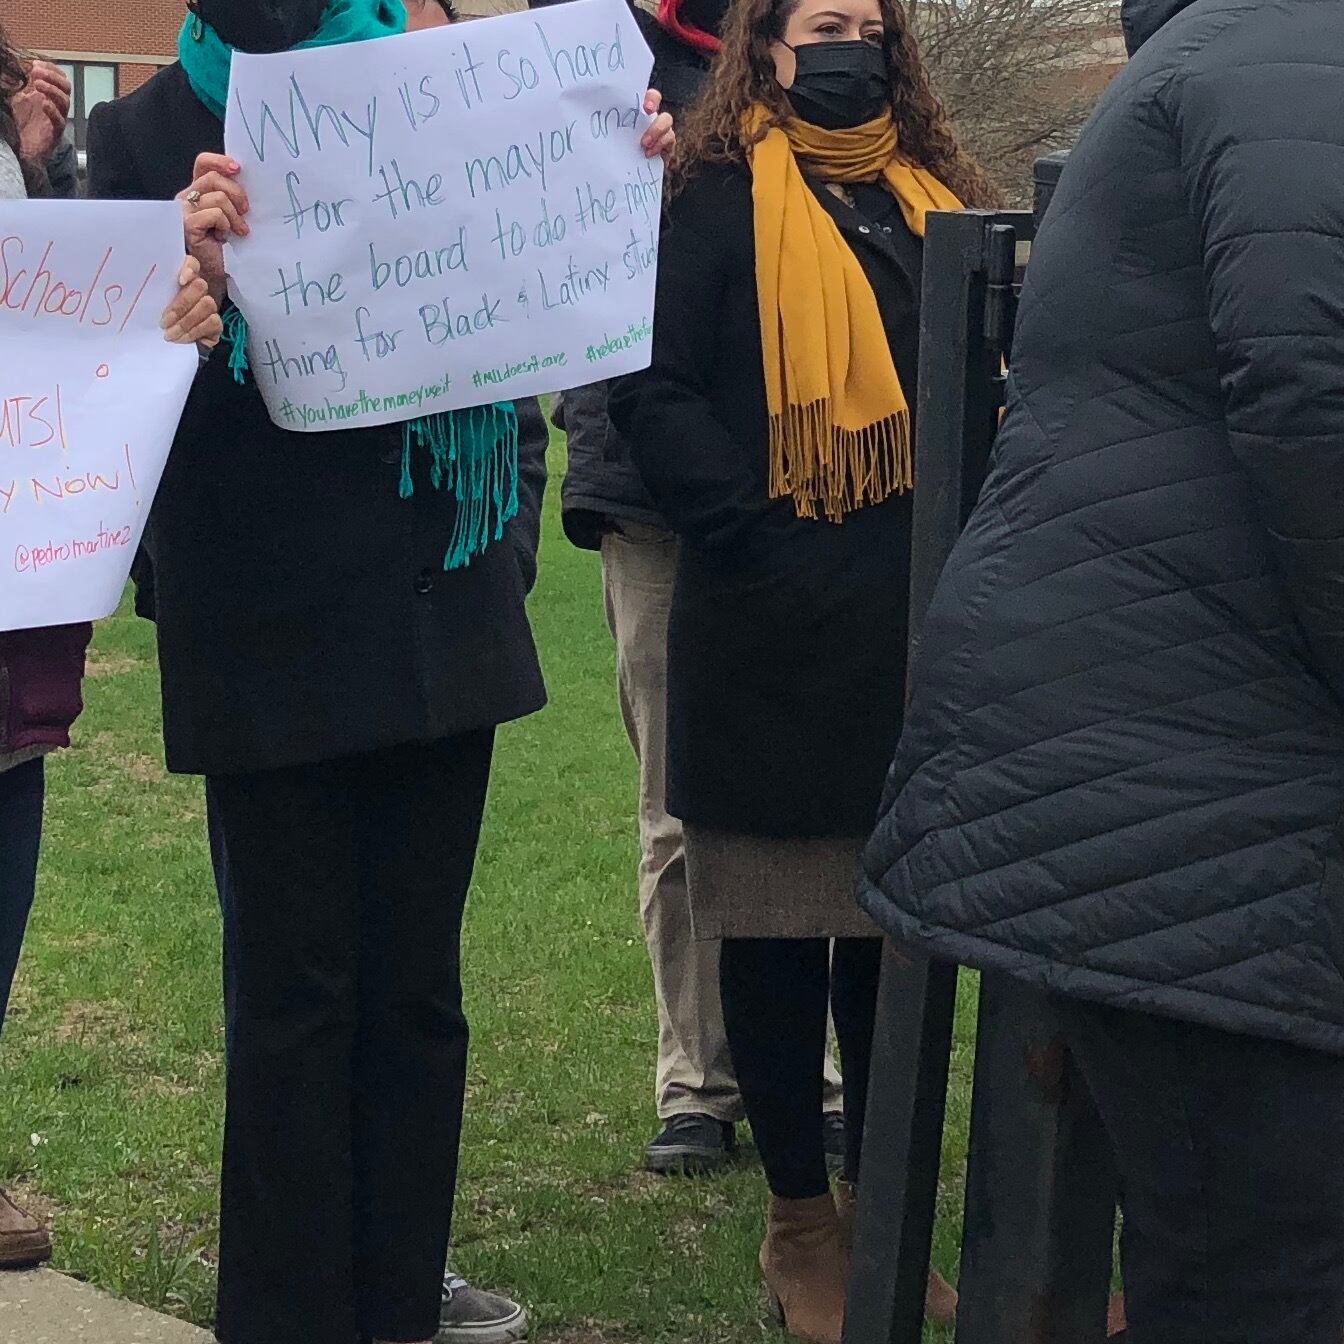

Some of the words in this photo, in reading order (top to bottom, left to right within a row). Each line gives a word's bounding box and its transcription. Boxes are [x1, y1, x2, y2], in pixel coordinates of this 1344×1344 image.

[235, 72, 377, 176] Why
[397, 67, 440, 131] is
[452, 42, 484, 110] it
[535, 22, 624, 87] hard
[283, 170, 354, 239] for
[372, 159, 445, 219] the
[465, 120, 576, 197] mayor
[590, 93, 640, 139] and
[269, 263, 346, 316] the
[370, 227, 468, 290] board
[492, 208, 526, 256] to
[534, 197, 566, 248] do
[576, 182, 618, 232] the
[624, 162, 660, 225] right
[263, 339, 348, 391] thing
[355, 307, 404, 363] for
[419, 296, 511, 344] Black
[538, 256, 610, 311] Latinx
